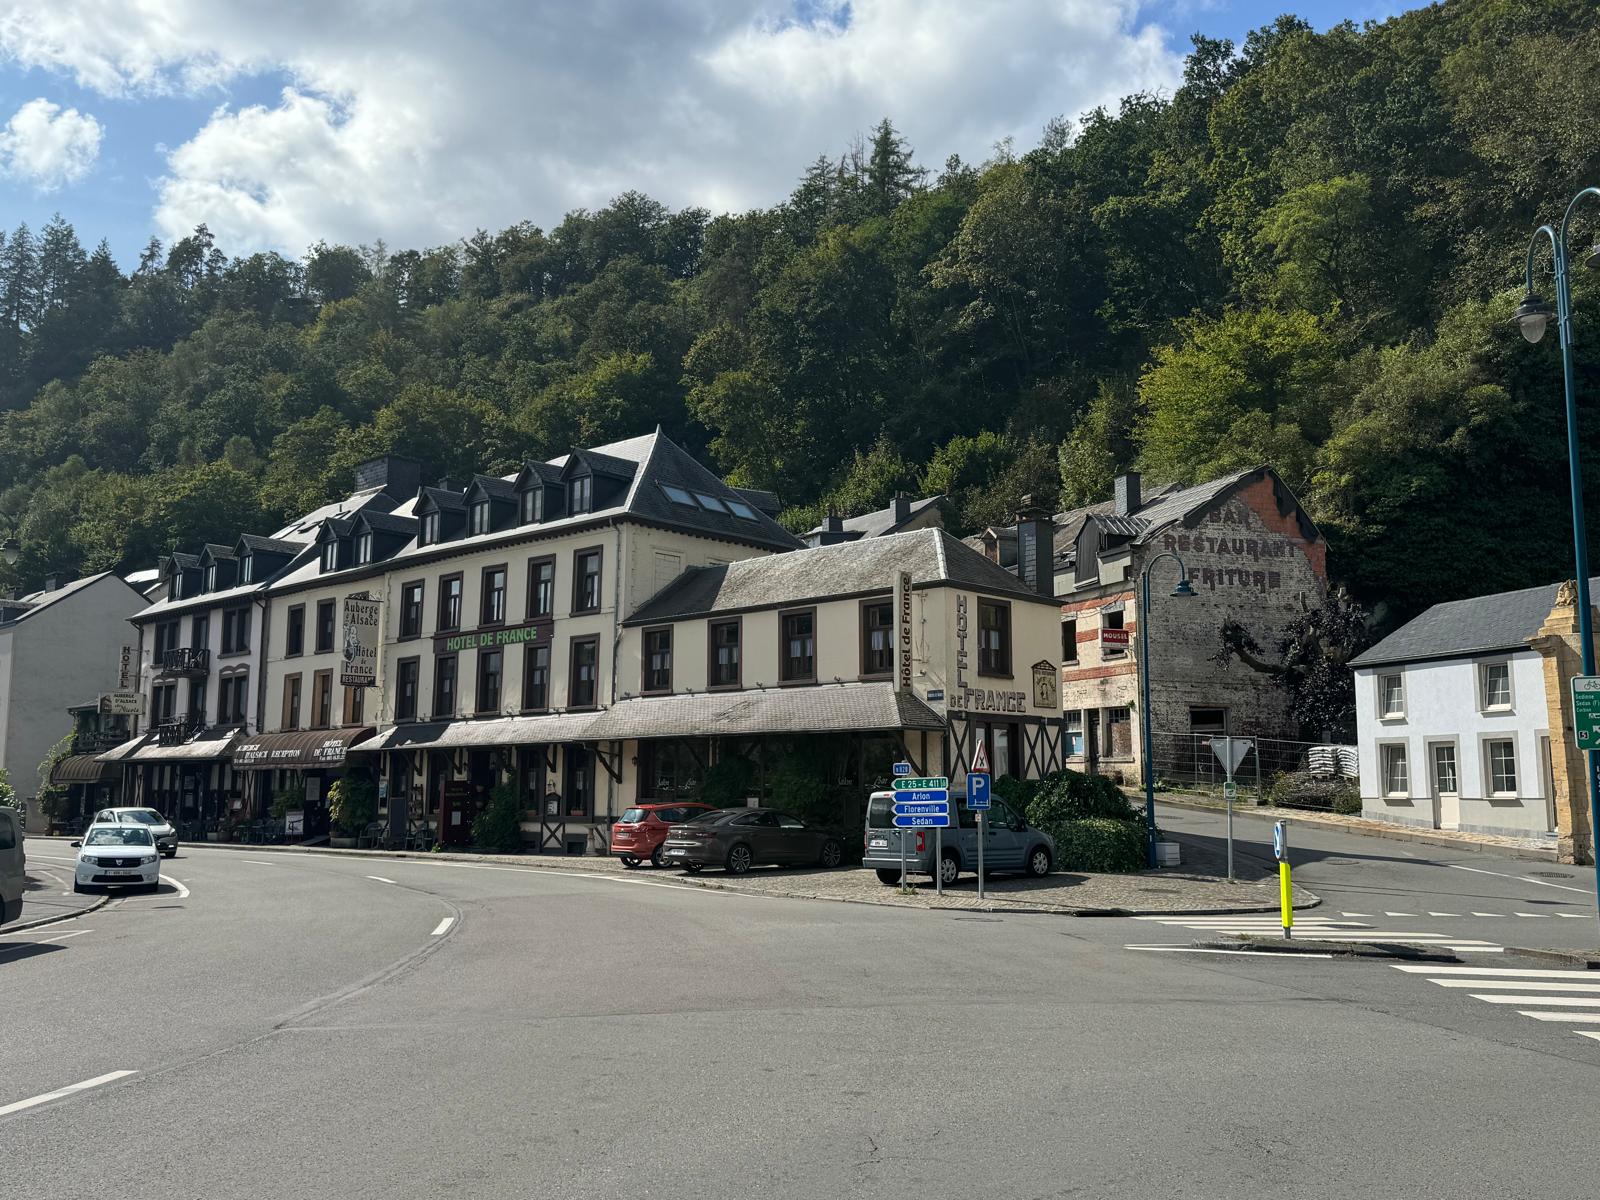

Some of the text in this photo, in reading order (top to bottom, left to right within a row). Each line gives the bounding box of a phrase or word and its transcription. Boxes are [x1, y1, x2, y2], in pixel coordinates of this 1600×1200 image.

[1162, 533, 1298, 562] RESTAURANT
[1187, 567, 1281, 593] FRITURE
[344, 600, 378, 616] Auberge
[447, 626, 537, 650] HOTEL DE FRANCE
[901, 576, 912, 688] Hôtel de France
[956, 594, 968, 689] HOTEL
[121, 646, 130, 688] HOTEL
[345, 661, 373, 675] France
[963, 688, 1027, 713] FRANCE
[901, 780, 906, 789] E
[907, 780, 917, 788] 25
[922, 780, 927, 788] E
[929, 780, 939, 788] 411
[973, 777, 984, 795] P
[912, 792, 931, 801] Arlon
[904, 805, 940, 813] Florenville
[911, 817, 933, 825] Sedan
